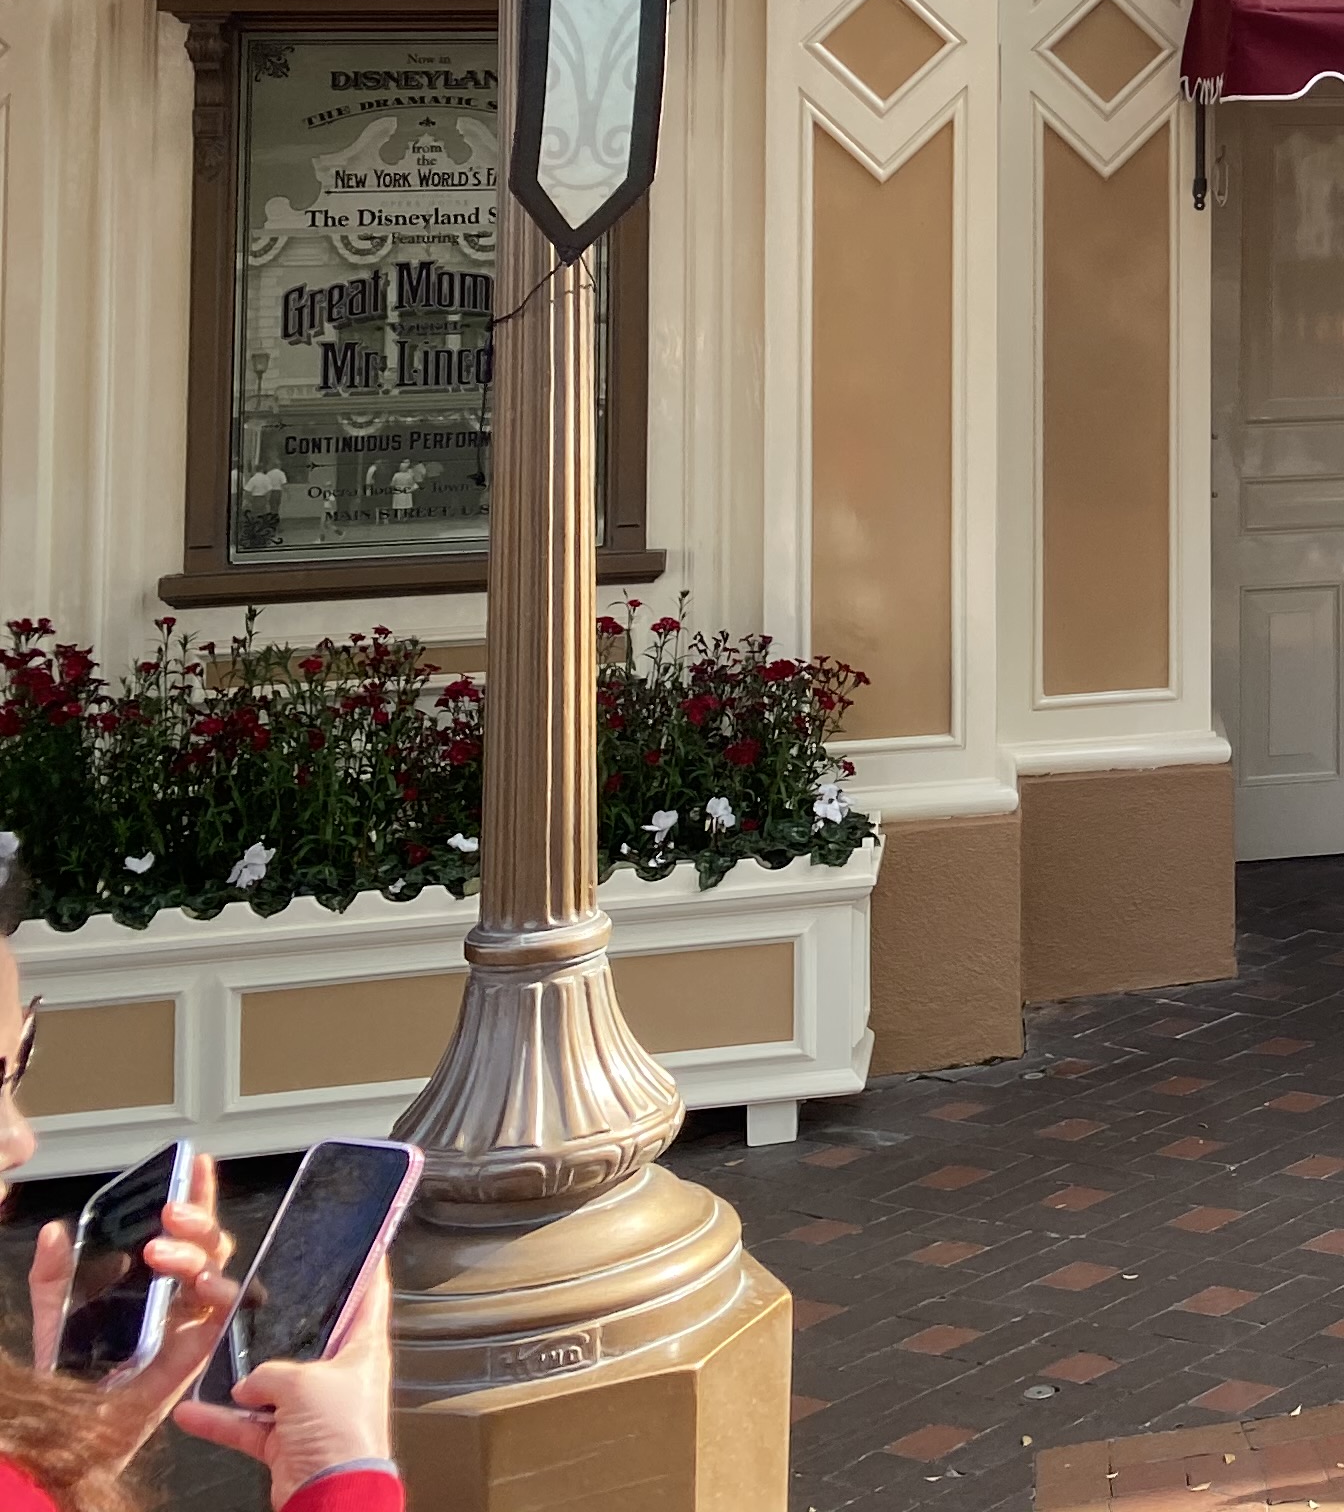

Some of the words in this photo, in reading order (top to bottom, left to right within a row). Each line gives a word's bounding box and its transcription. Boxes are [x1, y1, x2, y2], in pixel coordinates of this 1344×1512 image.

[406, 53, 435, 65] Now
[330, 70, 498, 91] DISNEYLAN
[304, 105, 351, 126] THE
[359, 95, 480, 111] DRAMATIC
[411, 141, 443, 154] from
[416, 155, 437, 166] the
[304, 209, 350, 228] The
[357, 206, 480, 230] Disneyland
[391, 232, 460, 246] Featuring
[281, 269, 389, 345] Great
[393, 260, 494, 315] Mom
[318, 340, 386, 394] Mr.
[395, 339, 494, 392] Linco
[284, 433, 402, 455] CONTINUOUS
[409, 431, 492, 450] PERFORM
